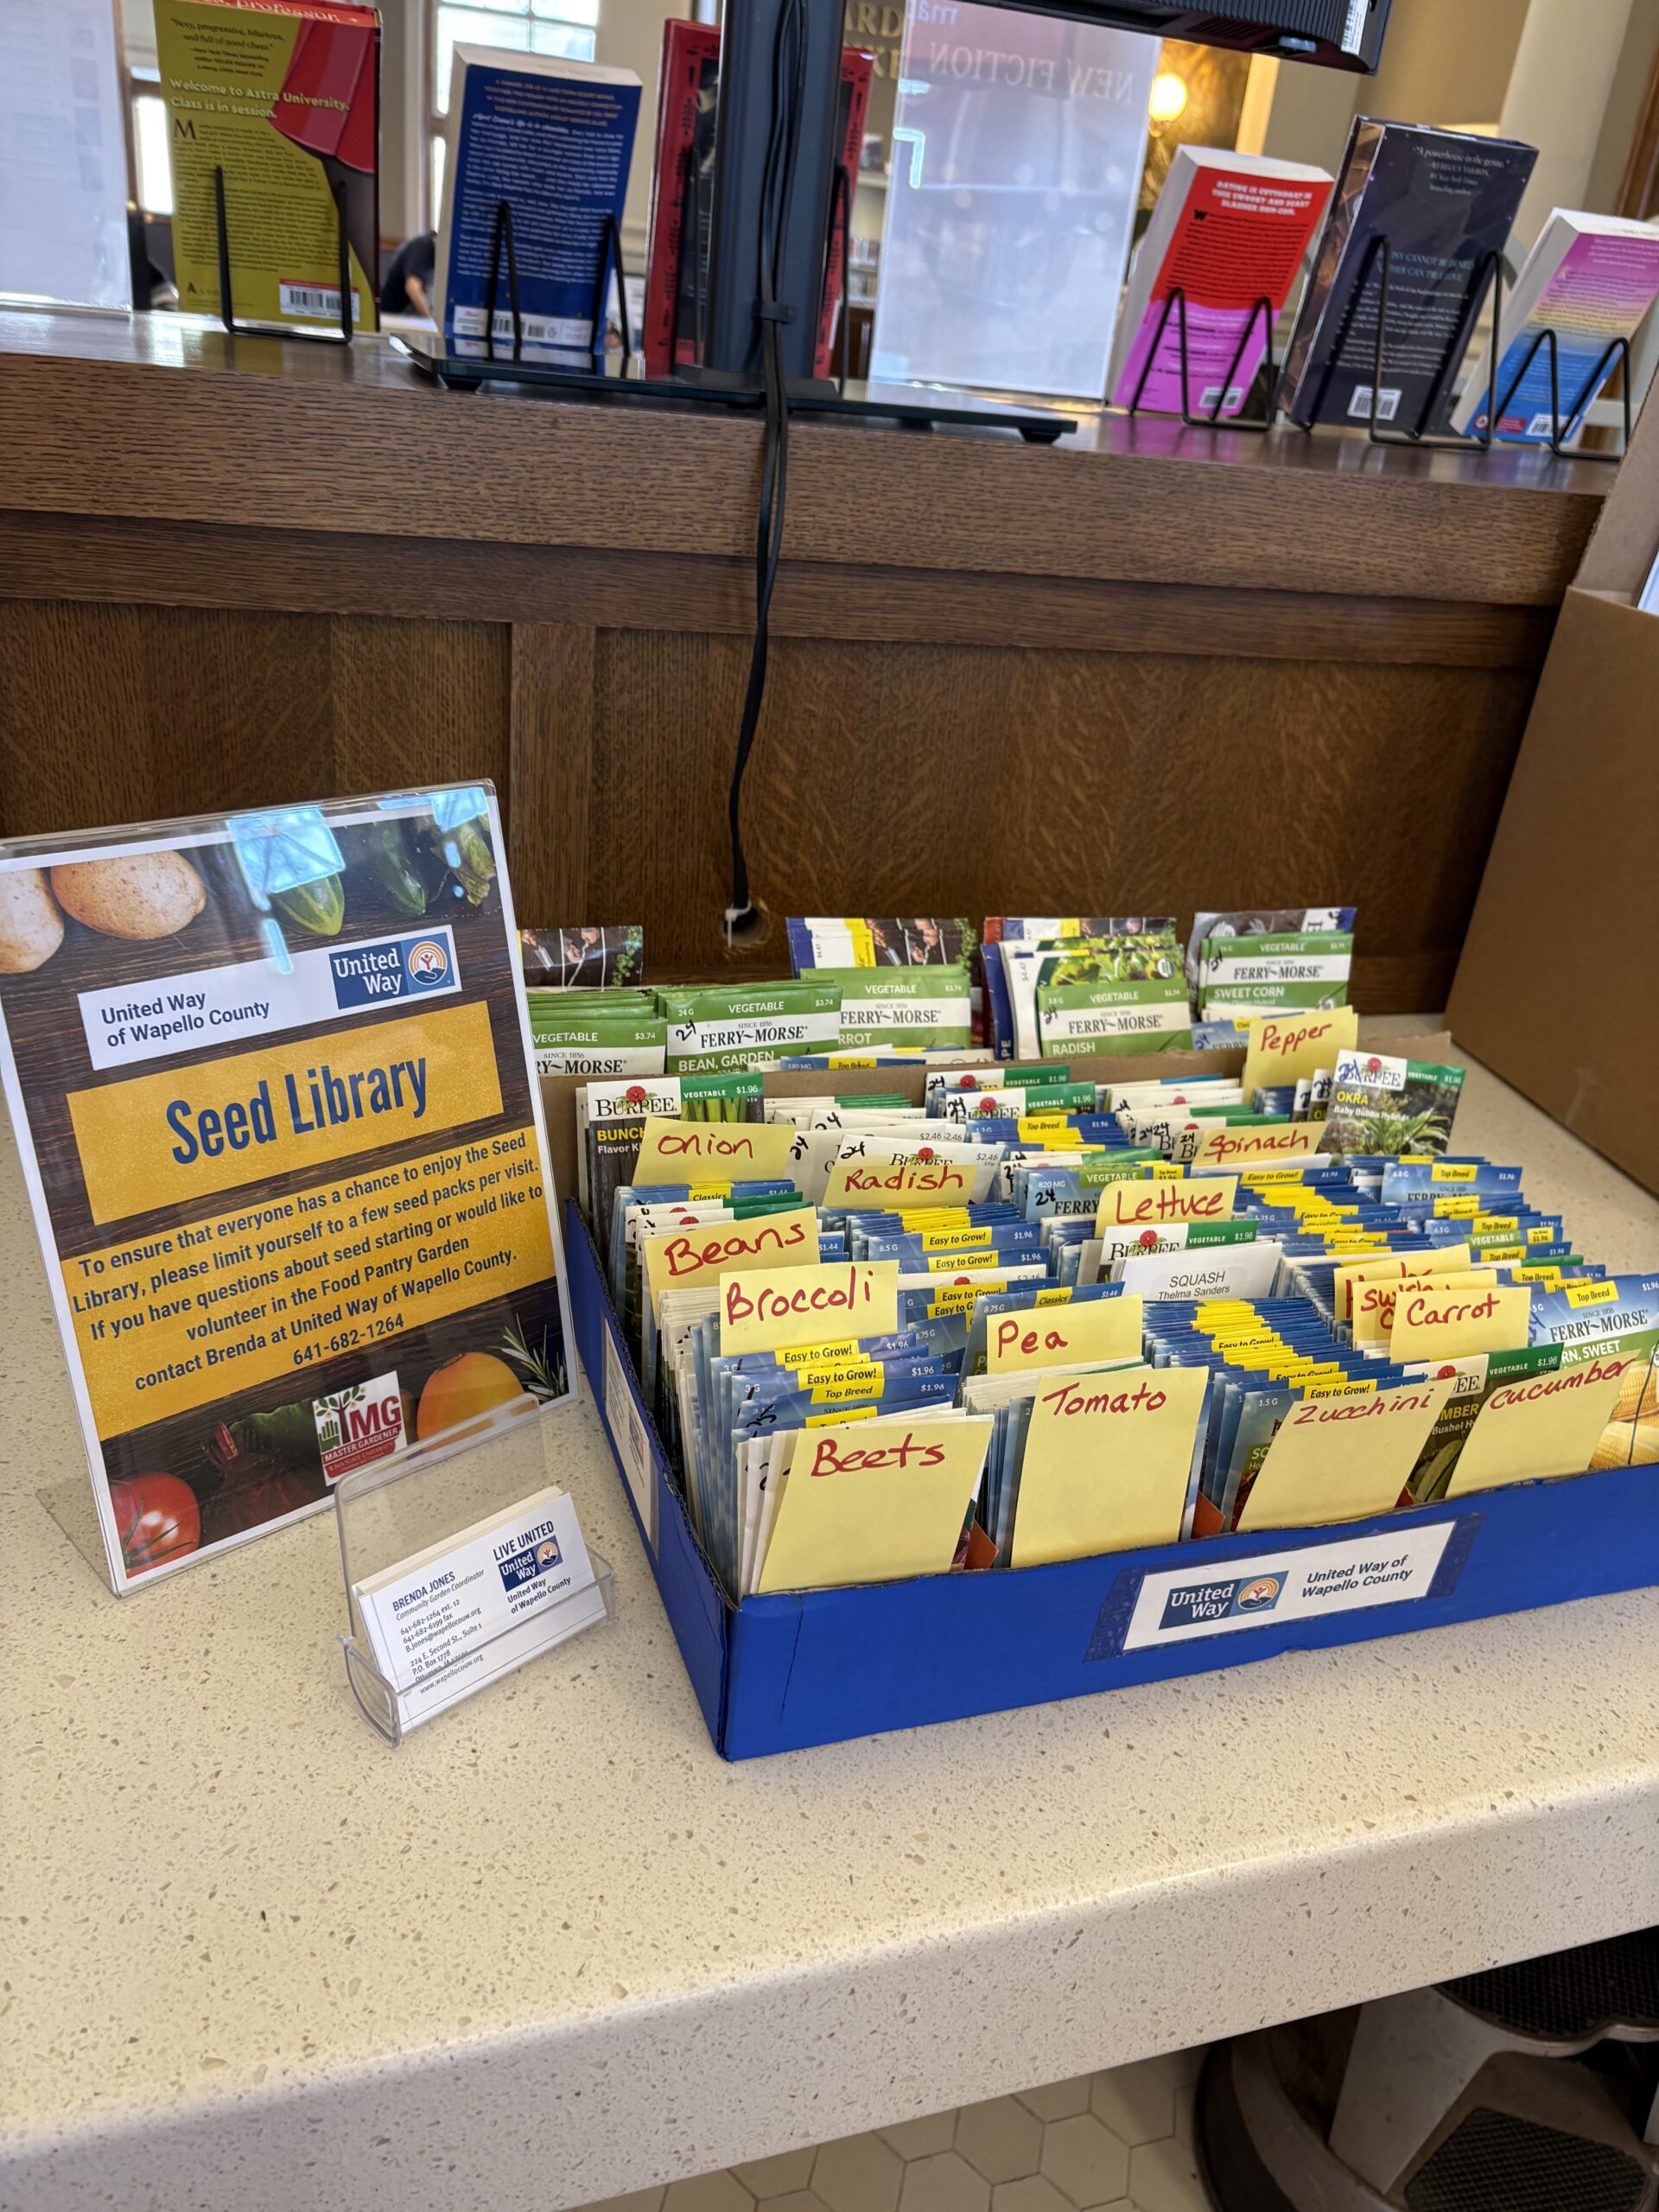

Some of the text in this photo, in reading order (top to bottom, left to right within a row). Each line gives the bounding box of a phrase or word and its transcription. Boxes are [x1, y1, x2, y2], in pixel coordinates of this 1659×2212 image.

[169, 78, 227, 96] Welcome
[229, 86, 245, 98] to
[246, 89, 279, 103] Astra
[170, 96, 202, 111] Class
[332, 947, 401, 978] United
[361, 972, 403, 995] Way
[865, 984, 918, 995] VEGETABLE
[1089, 991, 1140, 1004] VEGETABLE
[1214, 986, 1285, 1000] SWEET CORN
[100, 992, 206, 1025] United Way
[728, 1000, 785, 1014] VEGETABLE
[815, 998, 835, 1008] $3.74
[106, 1001, 270, 1047] of Wapello County
[1261, 1023, 1332, 1055] Pepper
[677, 1049, 775, 1073] BEAN, GARDEN
[1052, 1041, 1096, 1056] RADISH
[683, 1089, 727, 1099] VEGETABLE
[735, 1084, 759, 1095] $1.96
[1336, 1090, 1369, 1106] OKRA
[165, 1057, 427, 1165] Seed Library
[1204, 1129, 1309, 1163] Spinach
[844, 1166, 963, 1192] Radish
[77, 1131, 526, 1277] To ensure that everyone has a chance to enjoy the Seed
[1116, 1185, 1224, 1224] Lettuce
[72, 1158, 539, 1313] Library, please limit yourself to a few seed packs per visit.
[664, 1223, 805, 1276] Beans
[929, 1231, 987, 1247] Easy to Grow!
[89, 1185, 543, 1341] If you have questions about seed starting or would like to
[185, 1236, 470, 1341] volunteer in the Food Pantry Garden
[1158, 1284, 1230, 1301] Thelma Sanders
[1169, 1270, 1226, 1288] SQUASH
[727, 1266, 874, 1325] Broccoli
[1407, 1293, 1501, 1326] Carrot
[134, 1249, 517, 1390] contact Brenda at United Way of Wapello County.
[292, 1312, 404, 1365] 641-682-1264
[998, 1319, 1069, 1358] Pea
[1582, 1339, 1621, 1359] SWEET
[807, 1368, 877, 1385] Easy to Grow!
[912, 1365, 935, 1377] $1.96
[1042, 1382, 1166, 1415] Tomato
[1294, 1388, 1435, 1425] Zucchini
[349, 1395, 402, 1441] MG
[323, 1442, 358, 1462] MASTER
[356, 1426, 400, 1449] GARDENER
[810, 1433, 945, 1478] Beets
[493, 1520, 554, 1560] LIVE UNITED
[500, 1551, 533, 1575] United
[515, 1564, 535, 1580] Way
[1306, 1553, 1409, 1584] United Way of
[392, 1571, 455, 1611] BRENDA JONES
[396, 1569, 484, 1620] Community Garden Coordinator
[507, 1578, 545, 1603] United Way
[511, 1576, 570, 1613] of Wapello County
[1170, 1582, 1235, 1607] United
[1301, 1568, 1414, 1598] Wapello County
[400, 1610, 441, 1635] 641-682-1264
[441, 1603, 452, 1612] ext.
[1191, 1600, 1230, 1618] Way
[403, 1618, 442, 1643] 641-682-6199
[410, 1656, 423, 1667] 224
[422, 1651, 429, 1660] E.
[429, 1638, 451, 1656] Second
[450, 1635, 462, 1643] St.,
[461, 1624, 478, 1637] Suite
[412, 1664, 424, 1675] P.O.
[424, 1658, 436, 1669] Box
[436, 1649, 450, 1662] 1778
